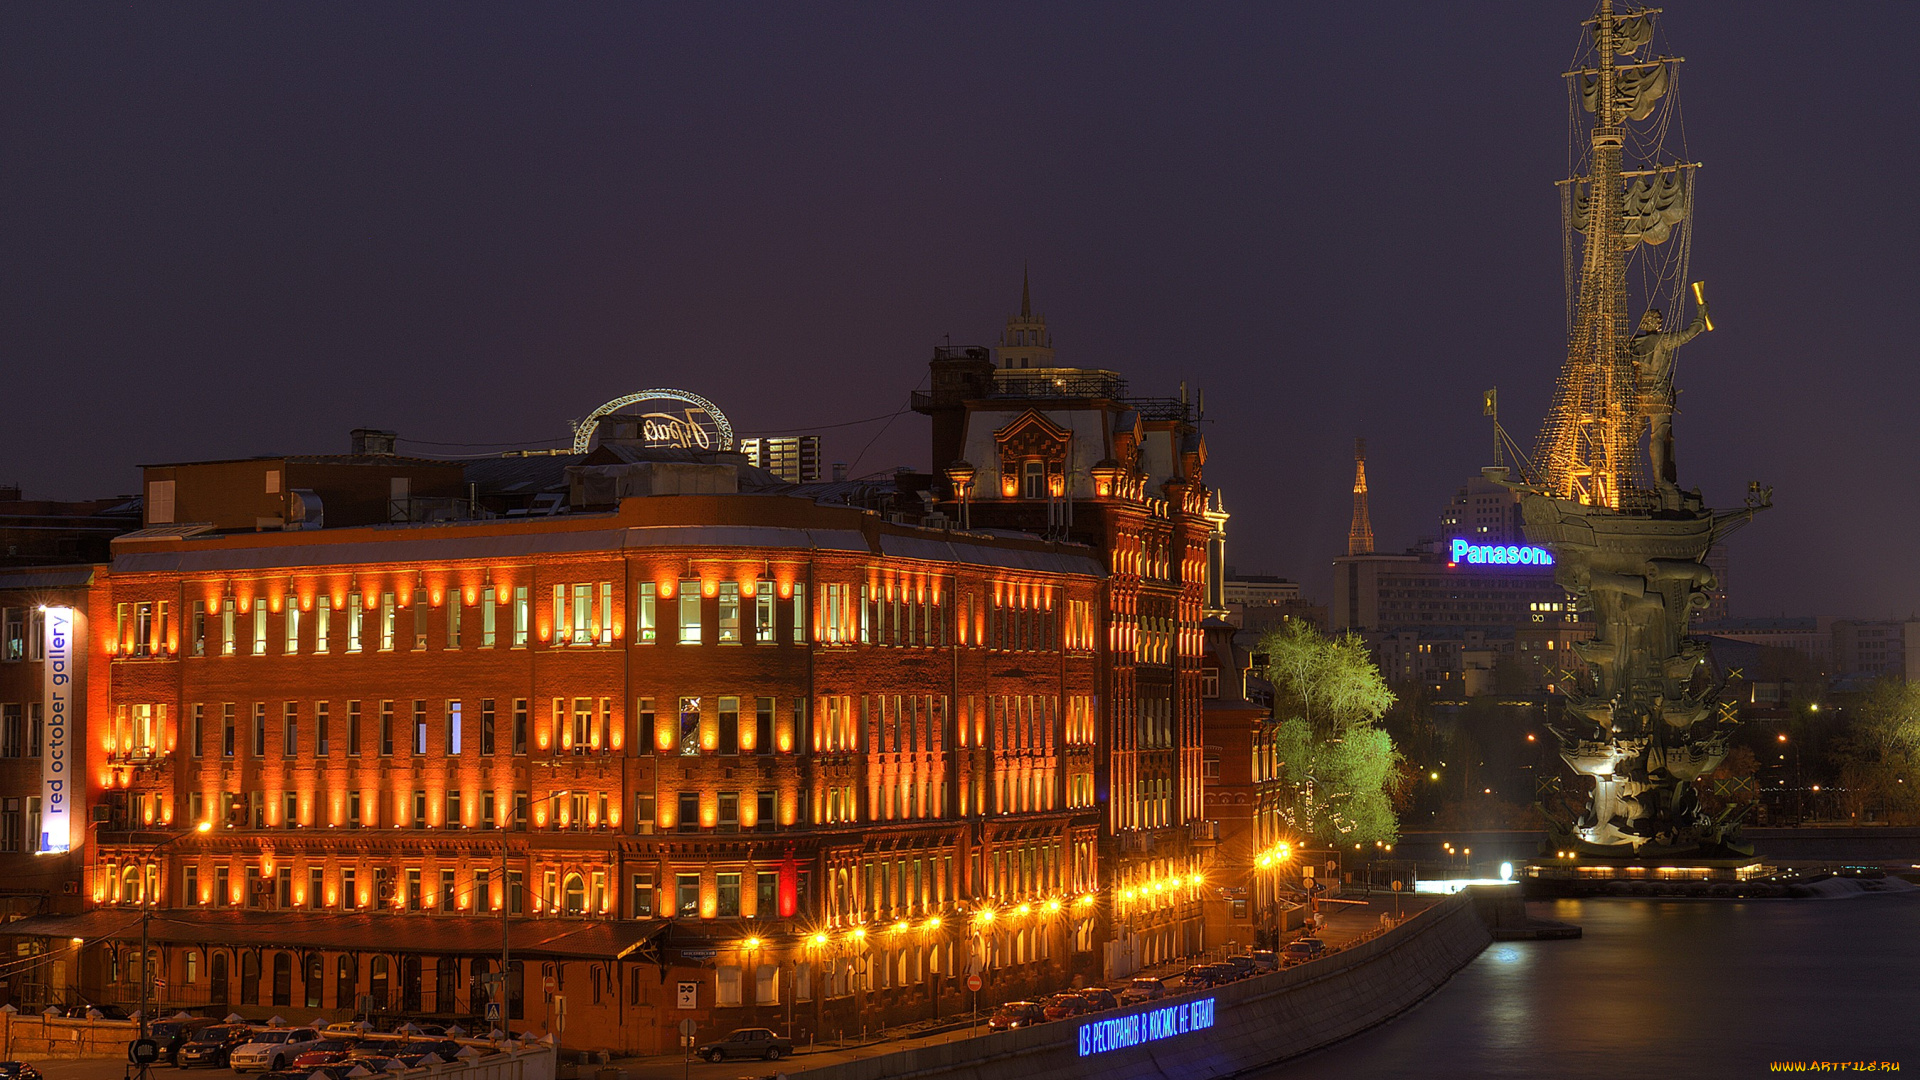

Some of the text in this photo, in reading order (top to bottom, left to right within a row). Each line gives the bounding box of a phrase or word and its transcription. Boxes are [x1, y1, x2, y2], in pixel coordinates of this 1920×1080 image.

[47, 615, 69, 813] red october gallery
[1079, 998, 1215, 1057] ИЗ РЕСТОРАНОВ В КОСМОС НЕ ЛЕТАЮТ
